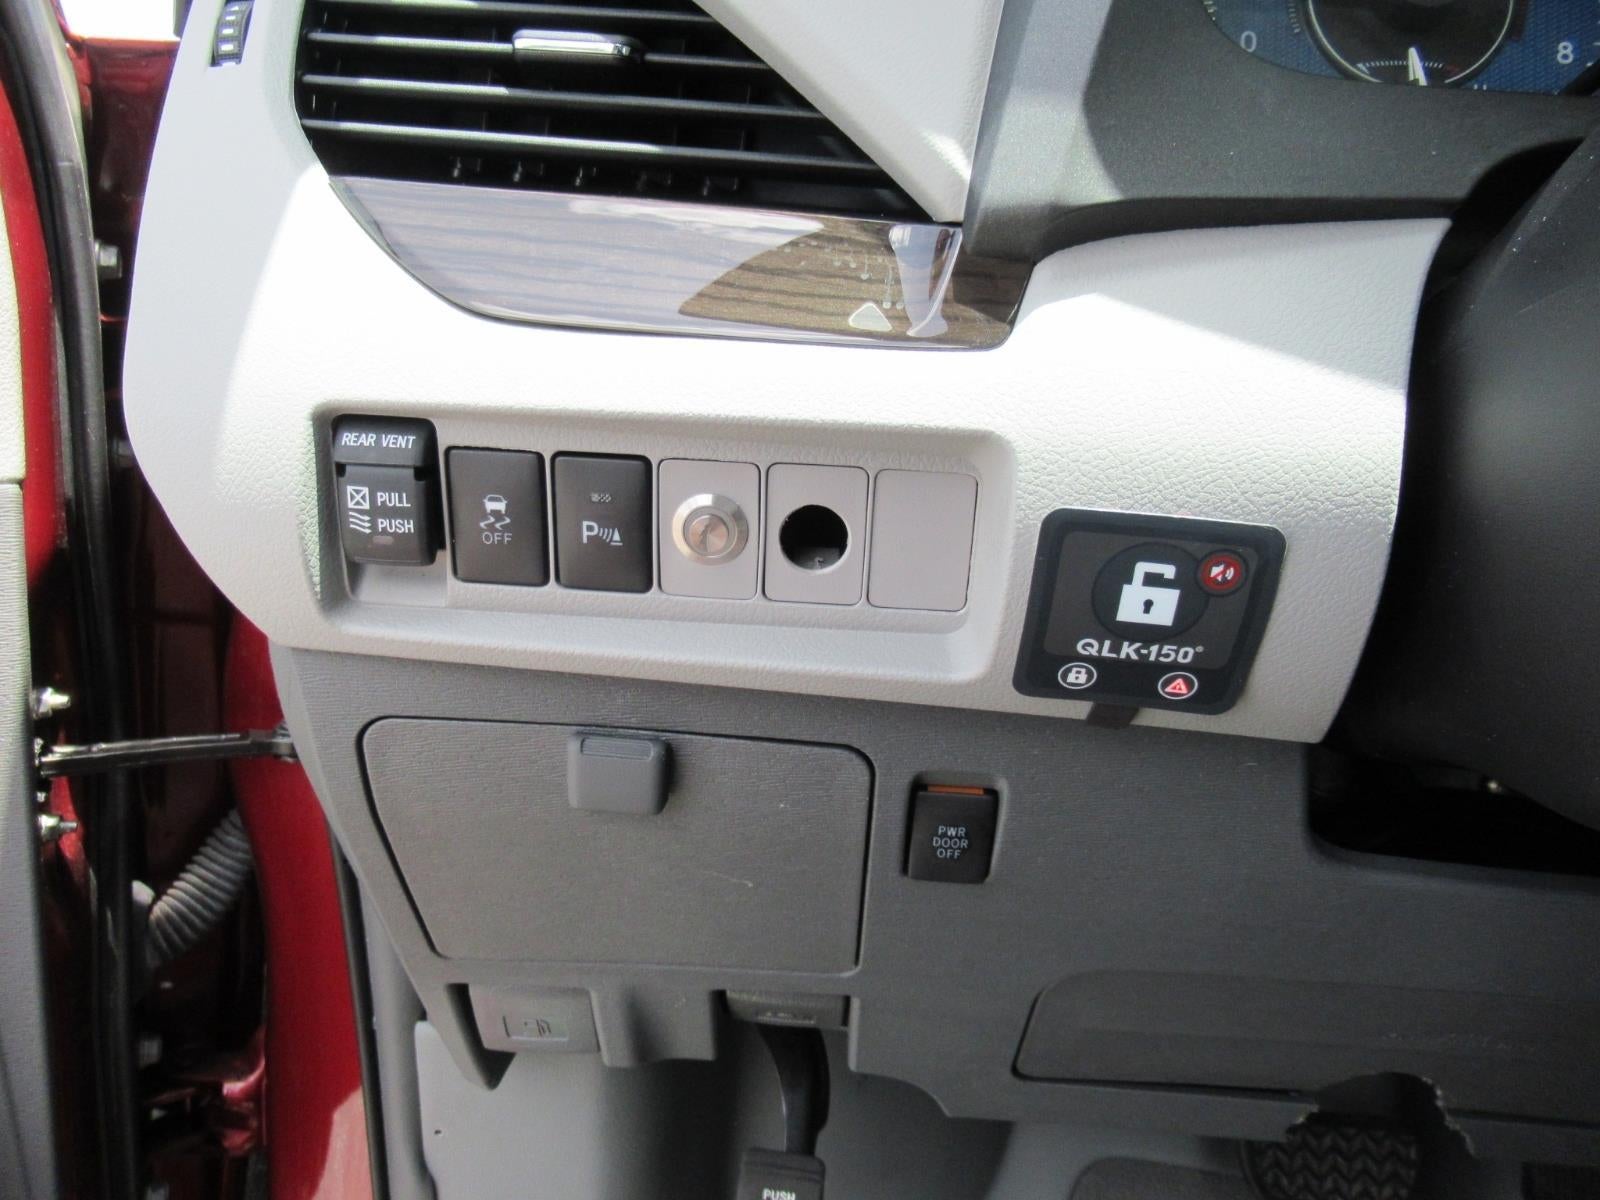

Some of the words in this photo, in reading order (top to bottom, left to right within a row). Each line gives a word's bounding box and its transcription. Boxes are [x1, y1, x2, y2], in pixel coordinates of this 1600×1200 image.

[1241, 30, 1257, 53] 0
[1557, 41, 1574, 65] 8
[341, 432, 376, 447] REAR
[381, 433, 416, 449] VENT
[376, 492, 411, 508] PULL
[377, 519, 414, 534] PUSH
[582, 520, 599, 544] P
[482, 532, 512, 545] OFF
[938, 825, 966, 837] PWR
[932, 836, 969, 849] DOOR
[936, 848, 961, 859] OFF
[762, 1188, 796, 1200] PUSH
